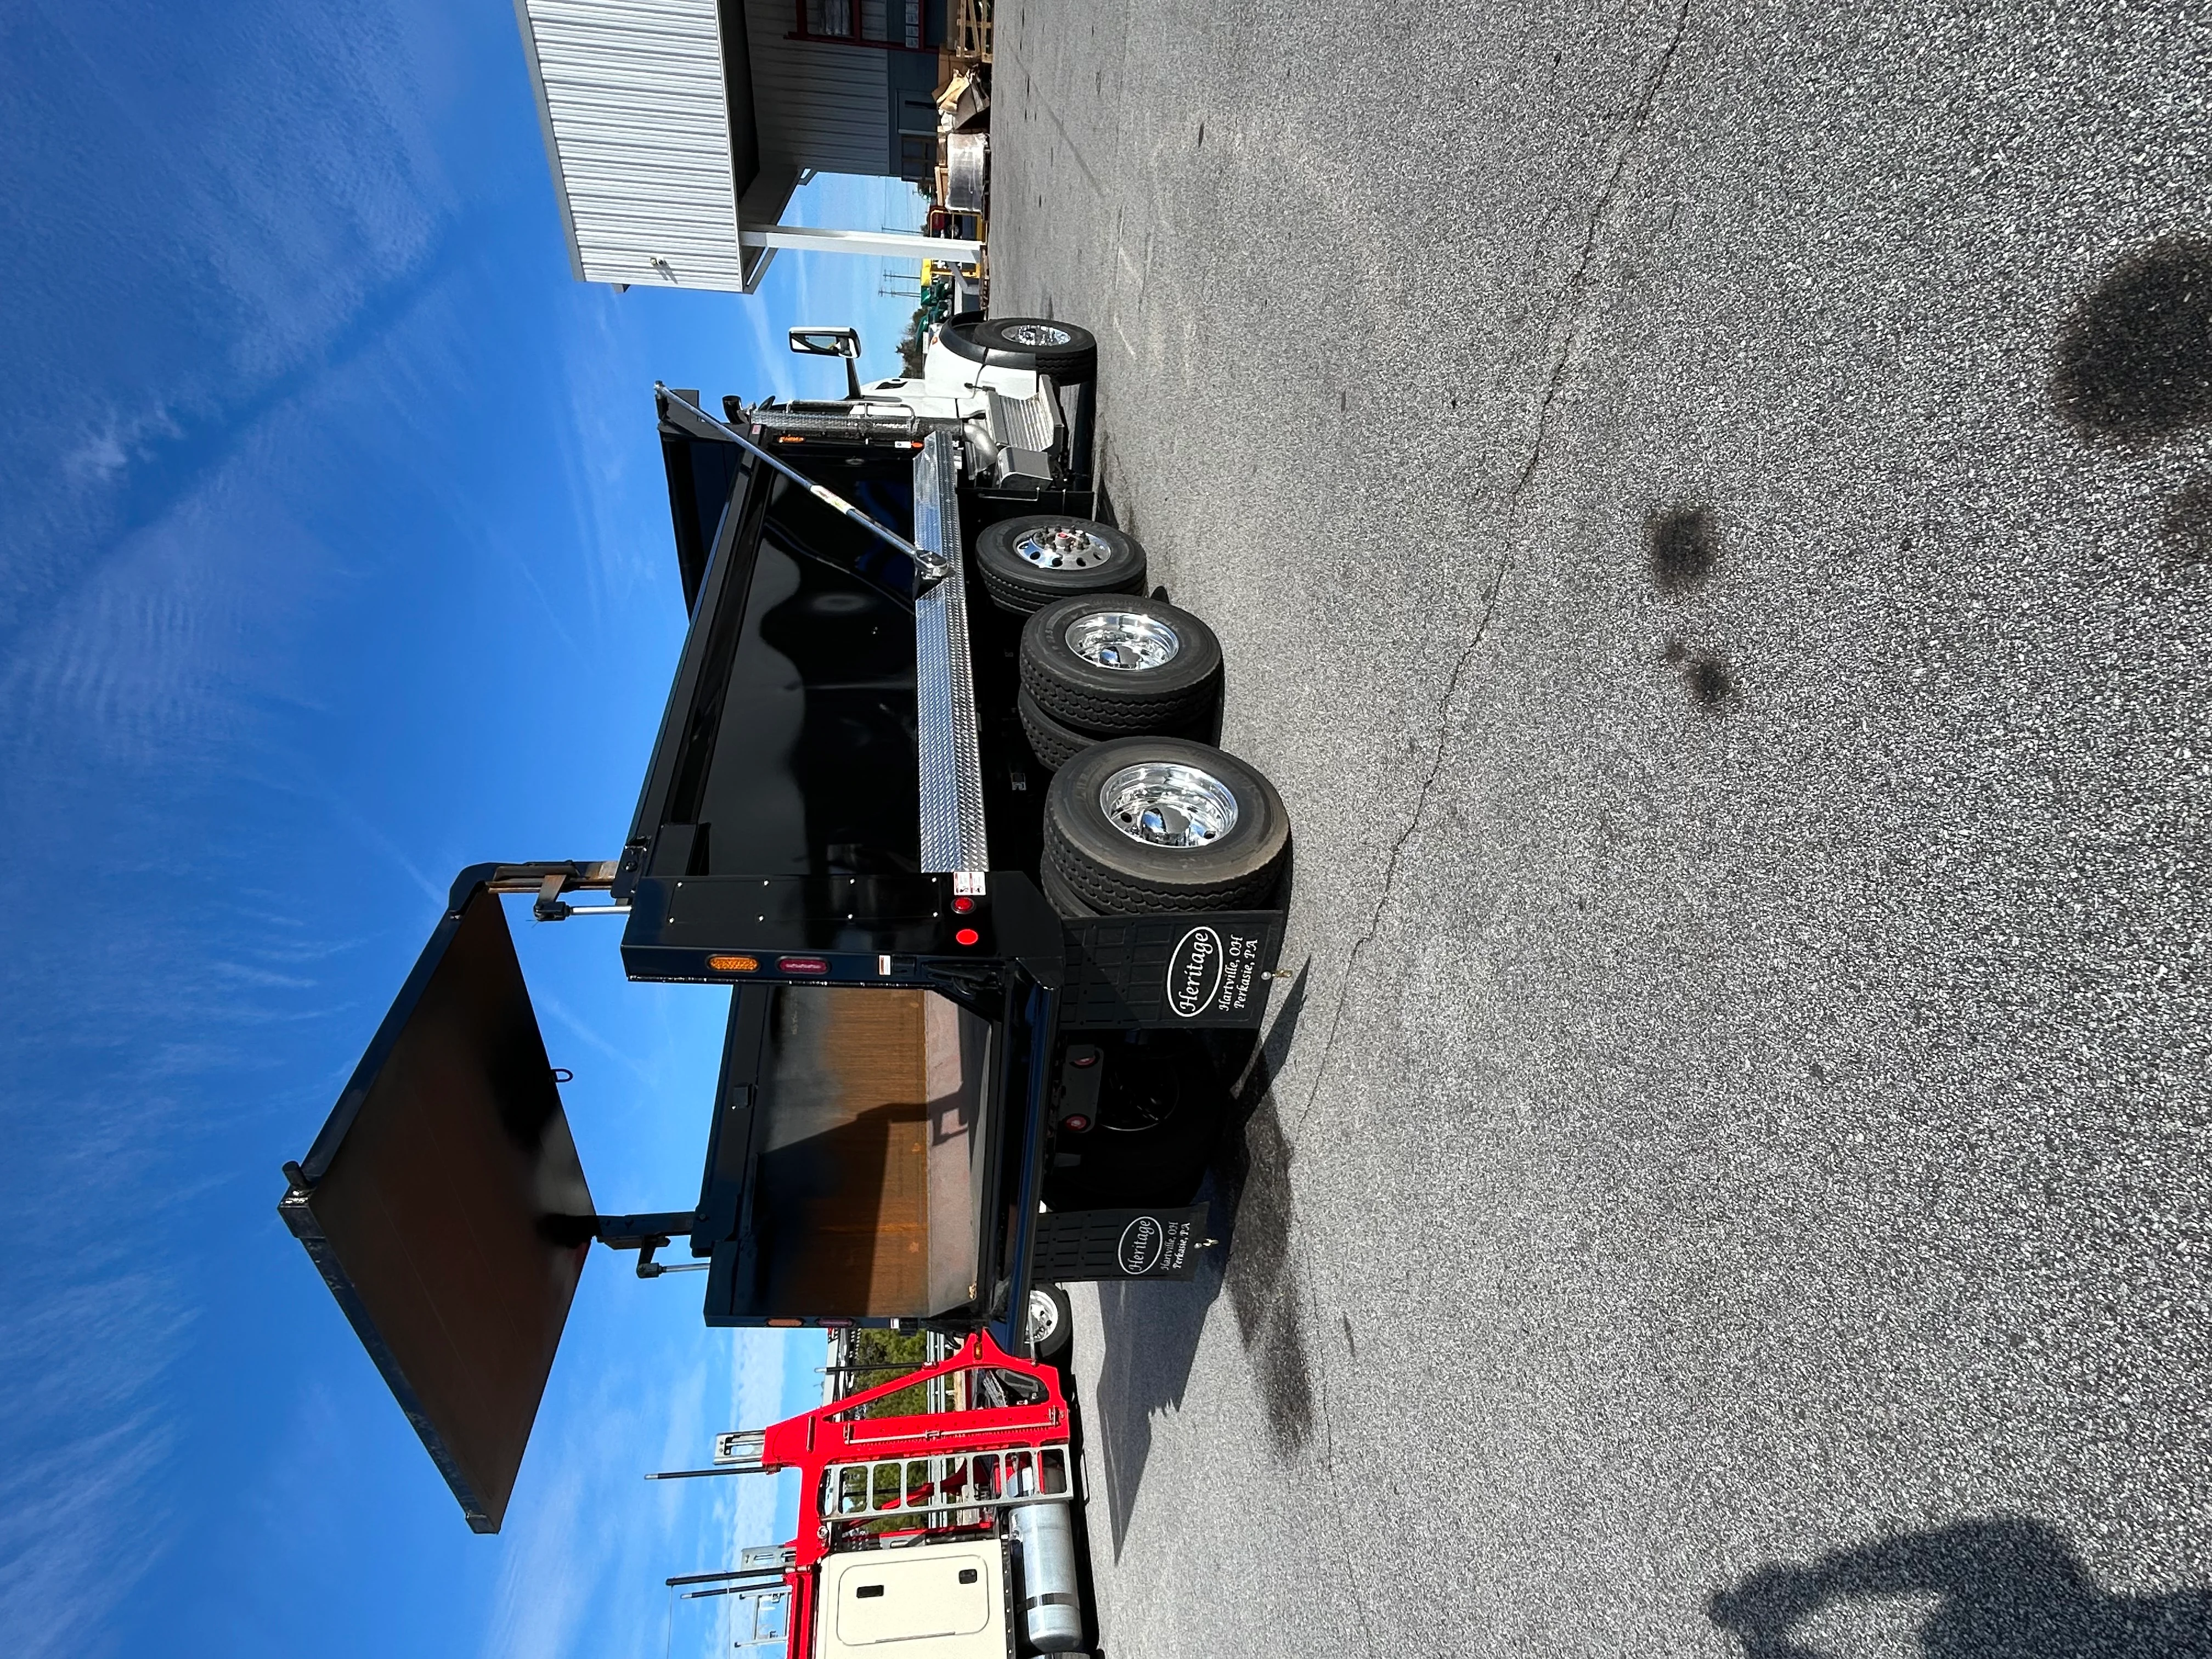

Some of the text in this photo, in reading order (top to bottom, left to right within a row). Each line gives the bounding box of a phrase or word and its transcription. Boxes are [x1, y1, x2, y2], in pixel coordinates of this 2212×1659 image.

[1178, 933, 1214, 1011] Heritage
[1218, 934, 1243, 1011] Hartville, OH
[1234, 939, 1258, 1008] Perkasie, PA
[1127, 1221, 1154, 1271] Heritage
[1160, 1221, 1178, 1270] Hartville, OH
[1173, 1222, 1190, 1268] Perkasie, PA
